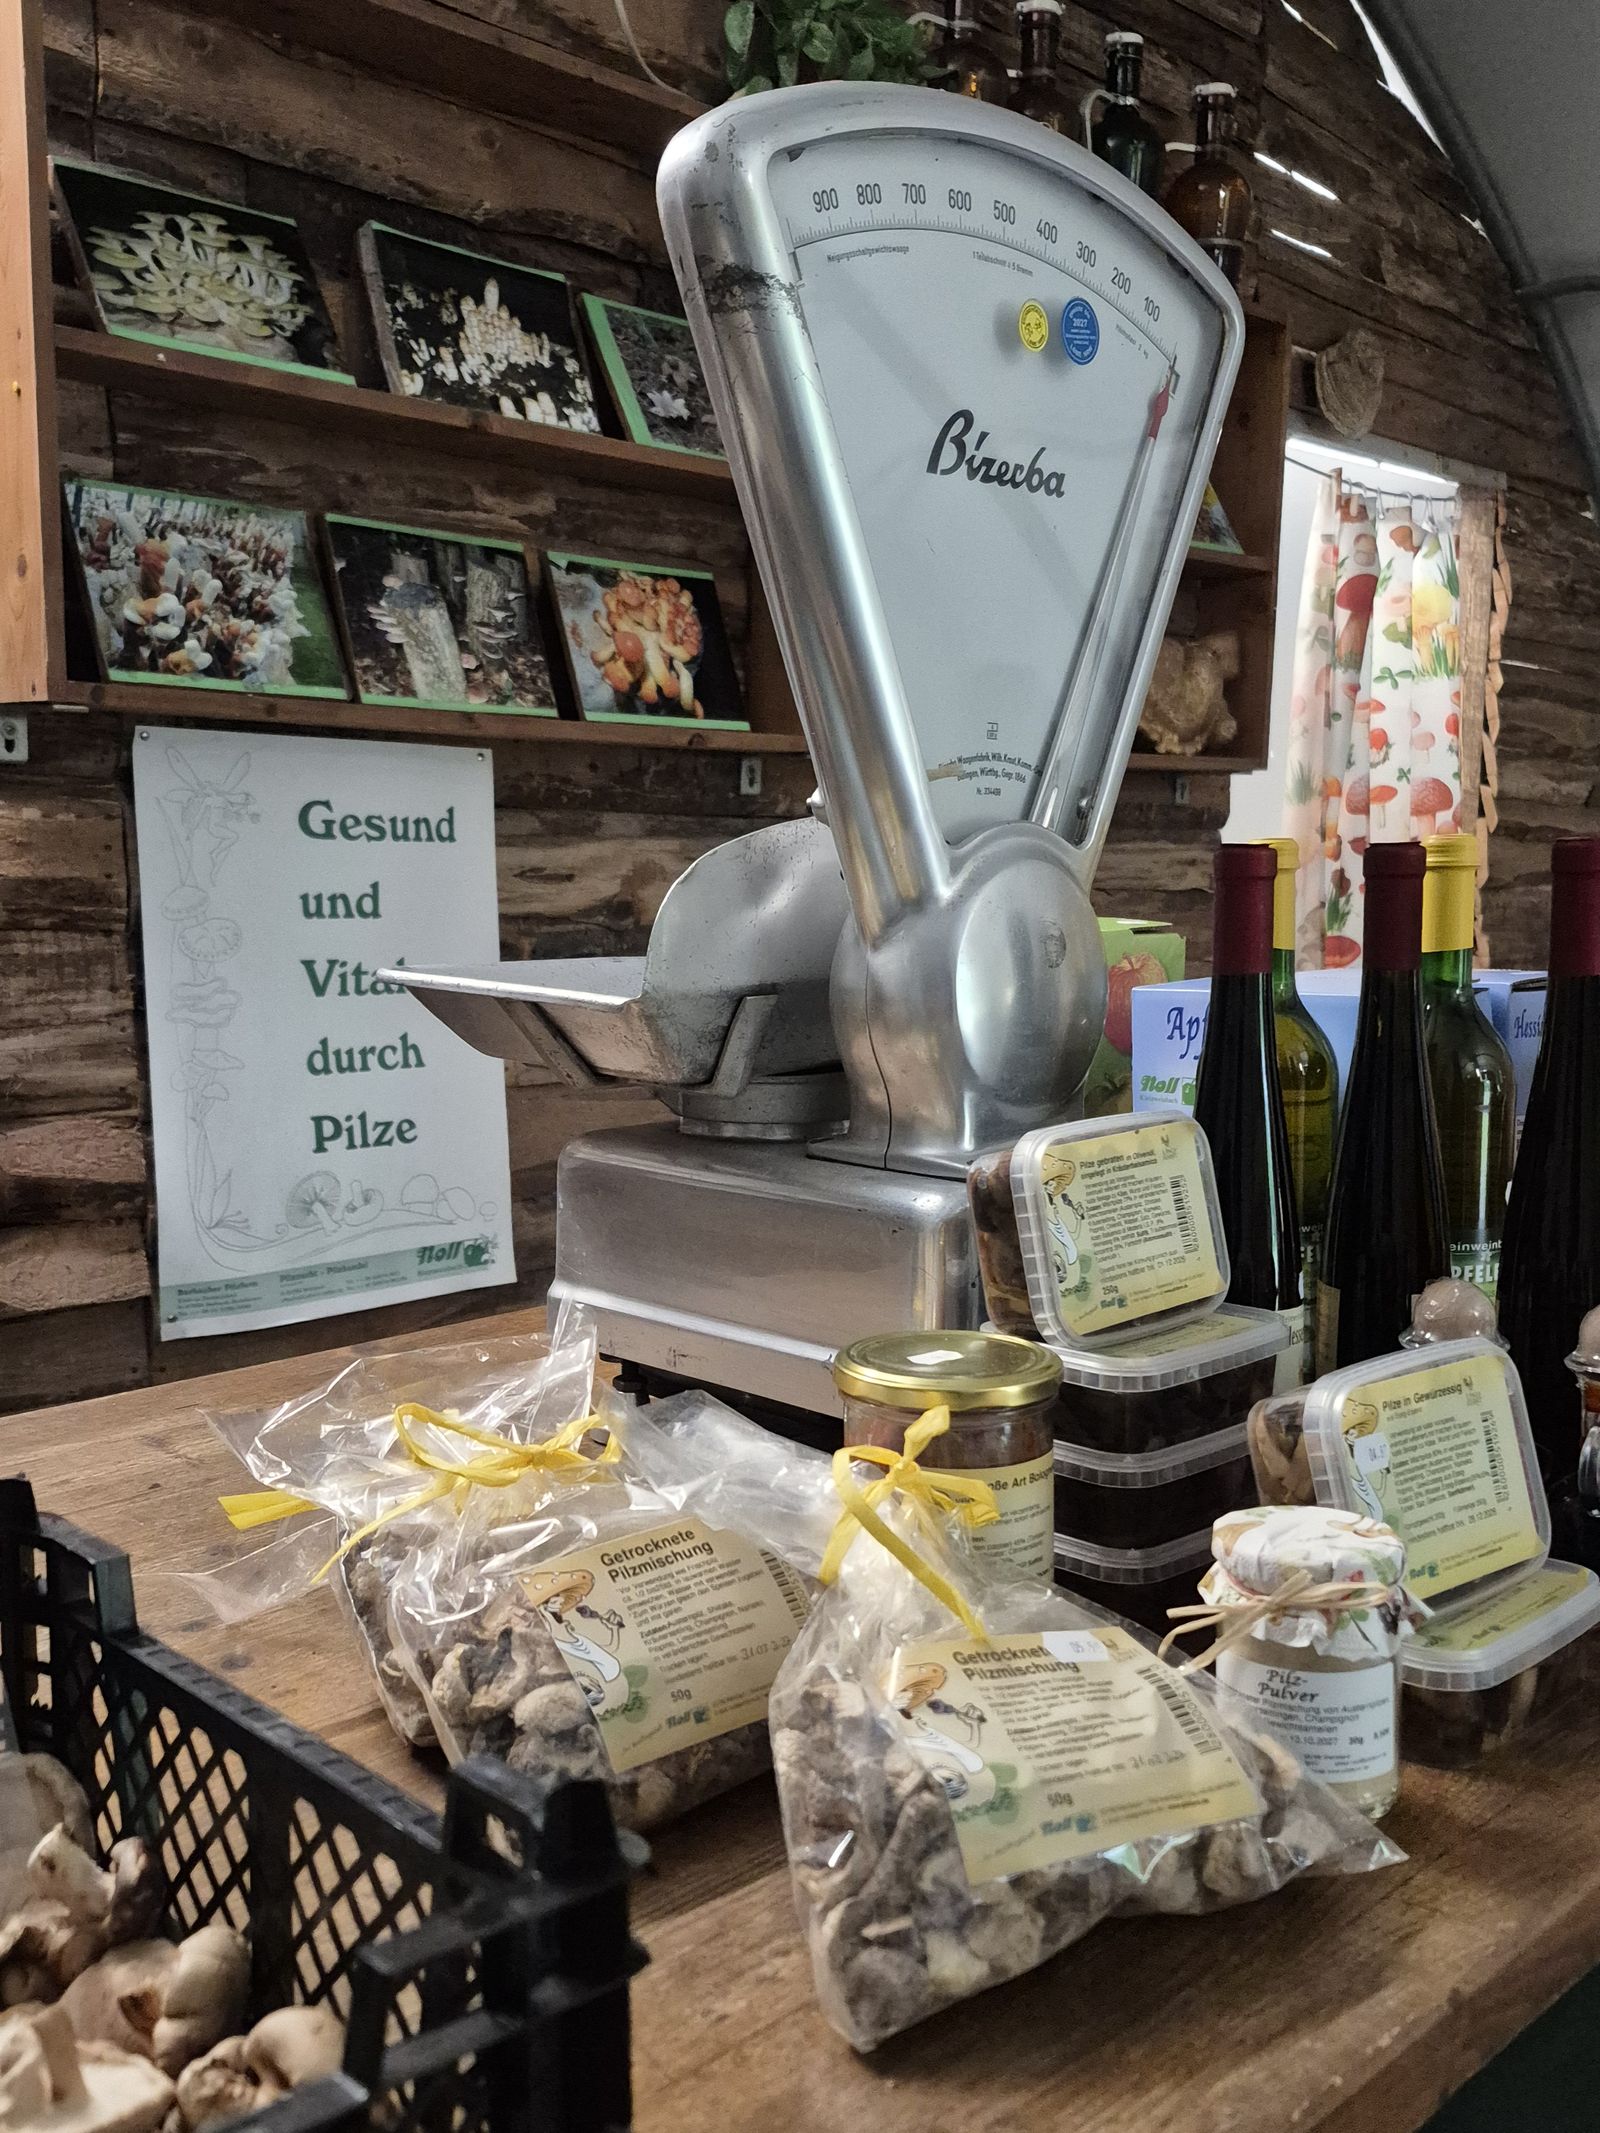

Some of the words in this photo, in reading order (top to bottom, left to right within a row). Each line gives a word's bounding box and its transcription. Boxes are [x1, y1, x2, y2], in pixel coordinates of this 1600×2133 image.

[812, 187, 839, 213] 900
[856, 183, 882, 206] 800
[901, 183, 926, 205] 700
[948, 189, 972, 212] 600
[993, 200, 1016, 225] 500
[1036, 219, 1058, 244] 400
[1076, 241, 1097, 267] 300
[1111, 267, 1132, 294] 200
[1143, 295, 1161, 322] 100
[926, 409, 1066, 499] Bizerba
[297, 799, 456, 844] Gesund
[300, 881, 382, 921] und
[306, 1034, 426, 1077] durch
[312, 1115, 419, 1154] Pilze
[1011, 1476, 1027, 1488] Art
[600, 1529, 696, 1567] Getrocknete
[608, 1541, 715, 1584] Pilzmischung
[953, 1645, 1053, 1666] Getrocknet
[962, 1662, 1081, 1682] Pilzmischung
[670, 1688, 693, 1703] 50g
[1256, 1682, 1320, 1702] Pulver
[1266, 1669, 1308, 1686] Pilz-
